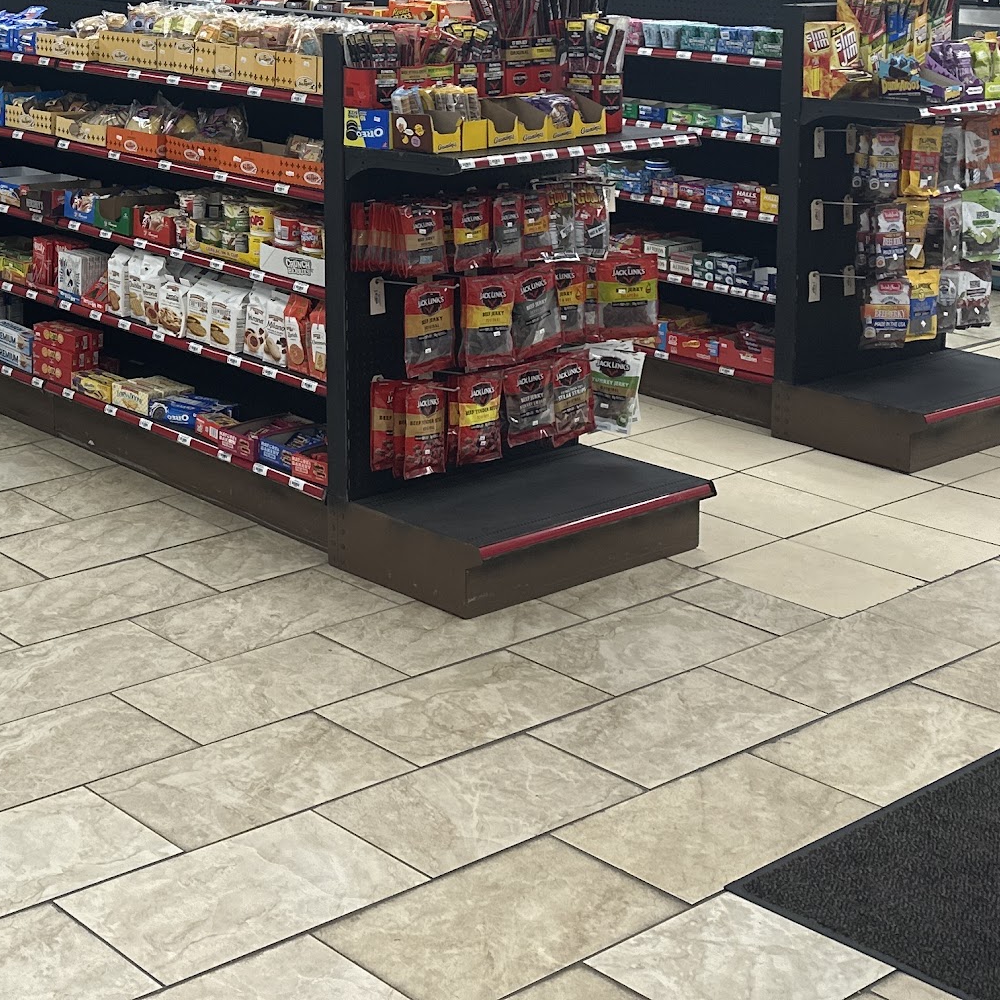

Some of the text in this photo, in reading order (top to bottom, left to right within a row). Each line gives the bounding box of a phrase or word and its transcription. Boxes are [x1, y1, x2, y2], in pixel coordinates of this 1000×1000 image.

[737, 190, 757, 199] HALLS
[284, 257, 312, 270] CRUNCH
[627, 268, 646, 276] LINK'S
[480, 292, 491, 301] JACK
[520, 287, 531, 296] JACK
[418, 300, 429, 309] JACK
[267, 320, 287, 332] Milano
[596, 360, 631, 371] JACK LINK'S
[528, 373, 544, 384] LINK'S
[556, 366, 583, 381] JACK LINK'S
[481, 387, 495, 396] LINK'S
[417, 398, 440, 409] JACK LINK'S
